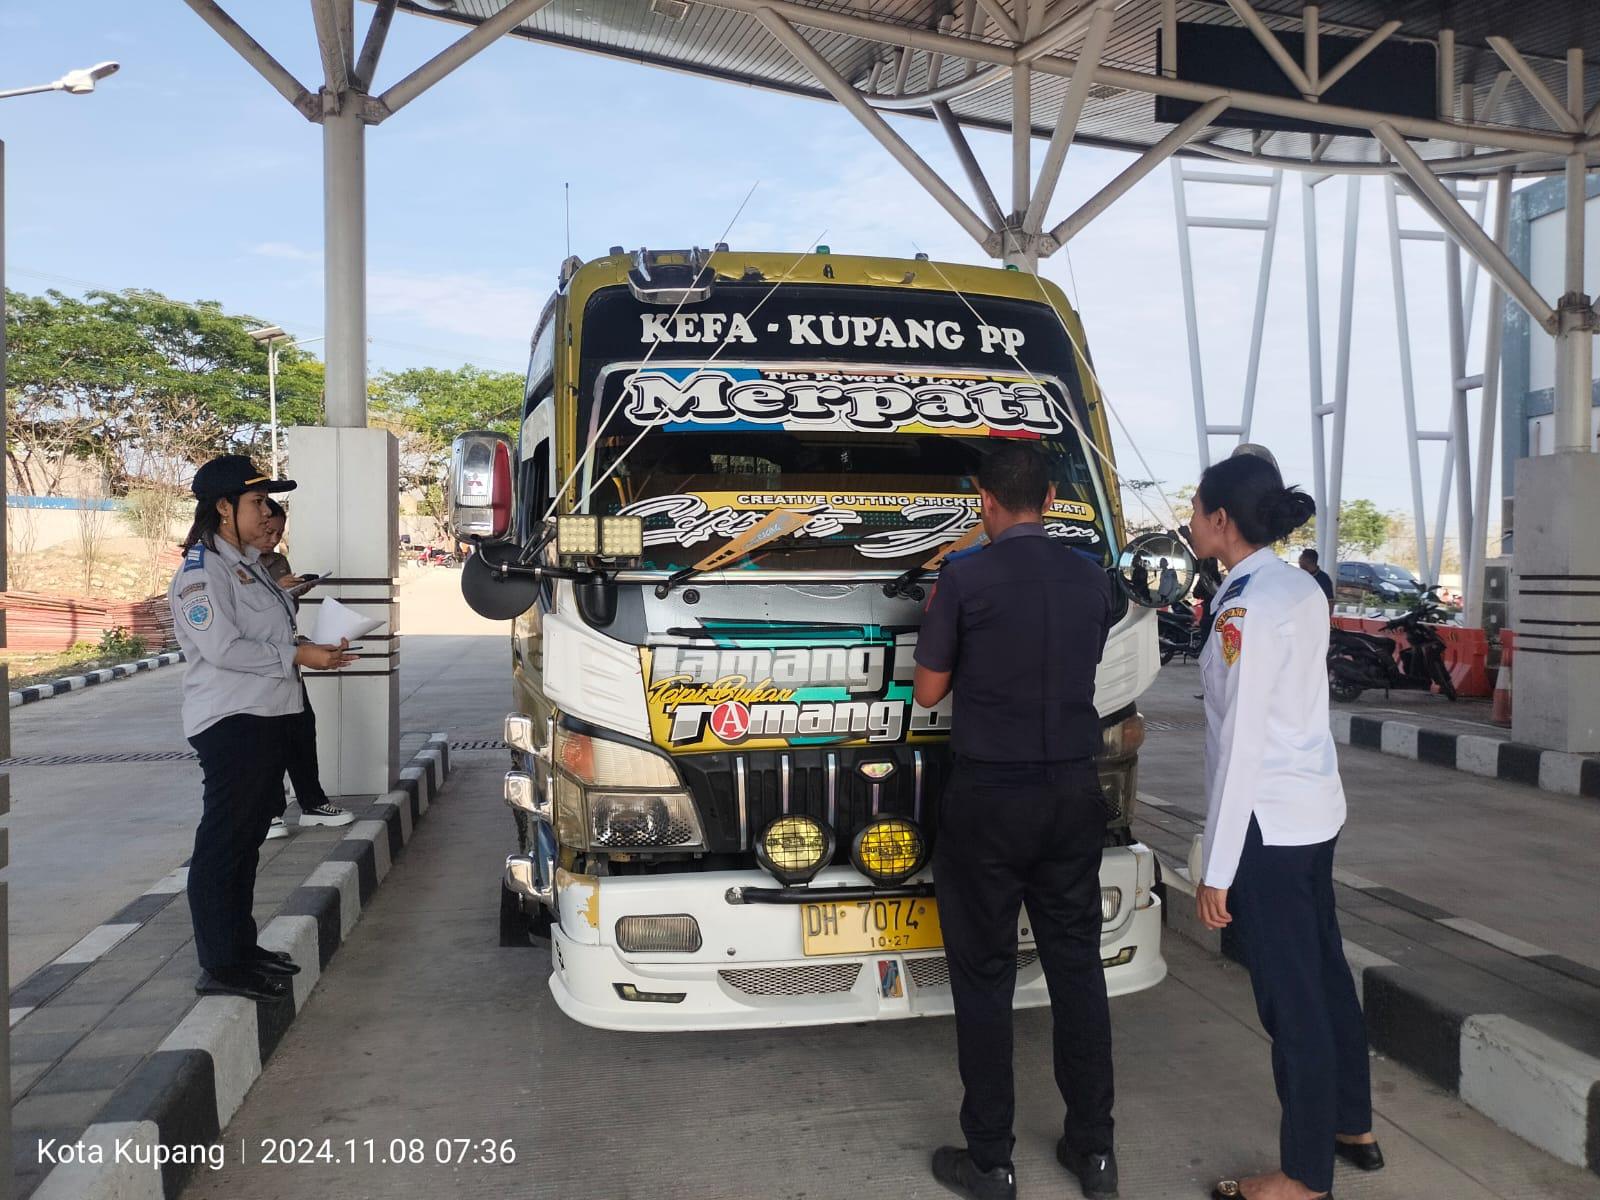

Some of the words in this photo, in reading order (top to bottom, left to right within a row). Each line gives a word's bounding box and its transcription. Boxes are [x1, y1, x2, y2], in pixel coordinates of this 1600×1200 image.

[640, 313, 757, 344] KEFA
[787, 314, 964, 350] KUPANG
[977, 324, 1026, 356] PP
[765, 371, 809, 381] The
[815, 371, 888, 384] Power
[893, 375, 925, 385] Of
[927, 376, 977, 388] Love
[624, 370, 1063, 434] Merpati
[737, 494, 826, 506] CREATIVE
[831, 495, 910, 506] CUTTING
[705, 674, 796, 704] Bukan
[807, 904, 838, 937] DH
[857, 900, 919, 933] 7074
